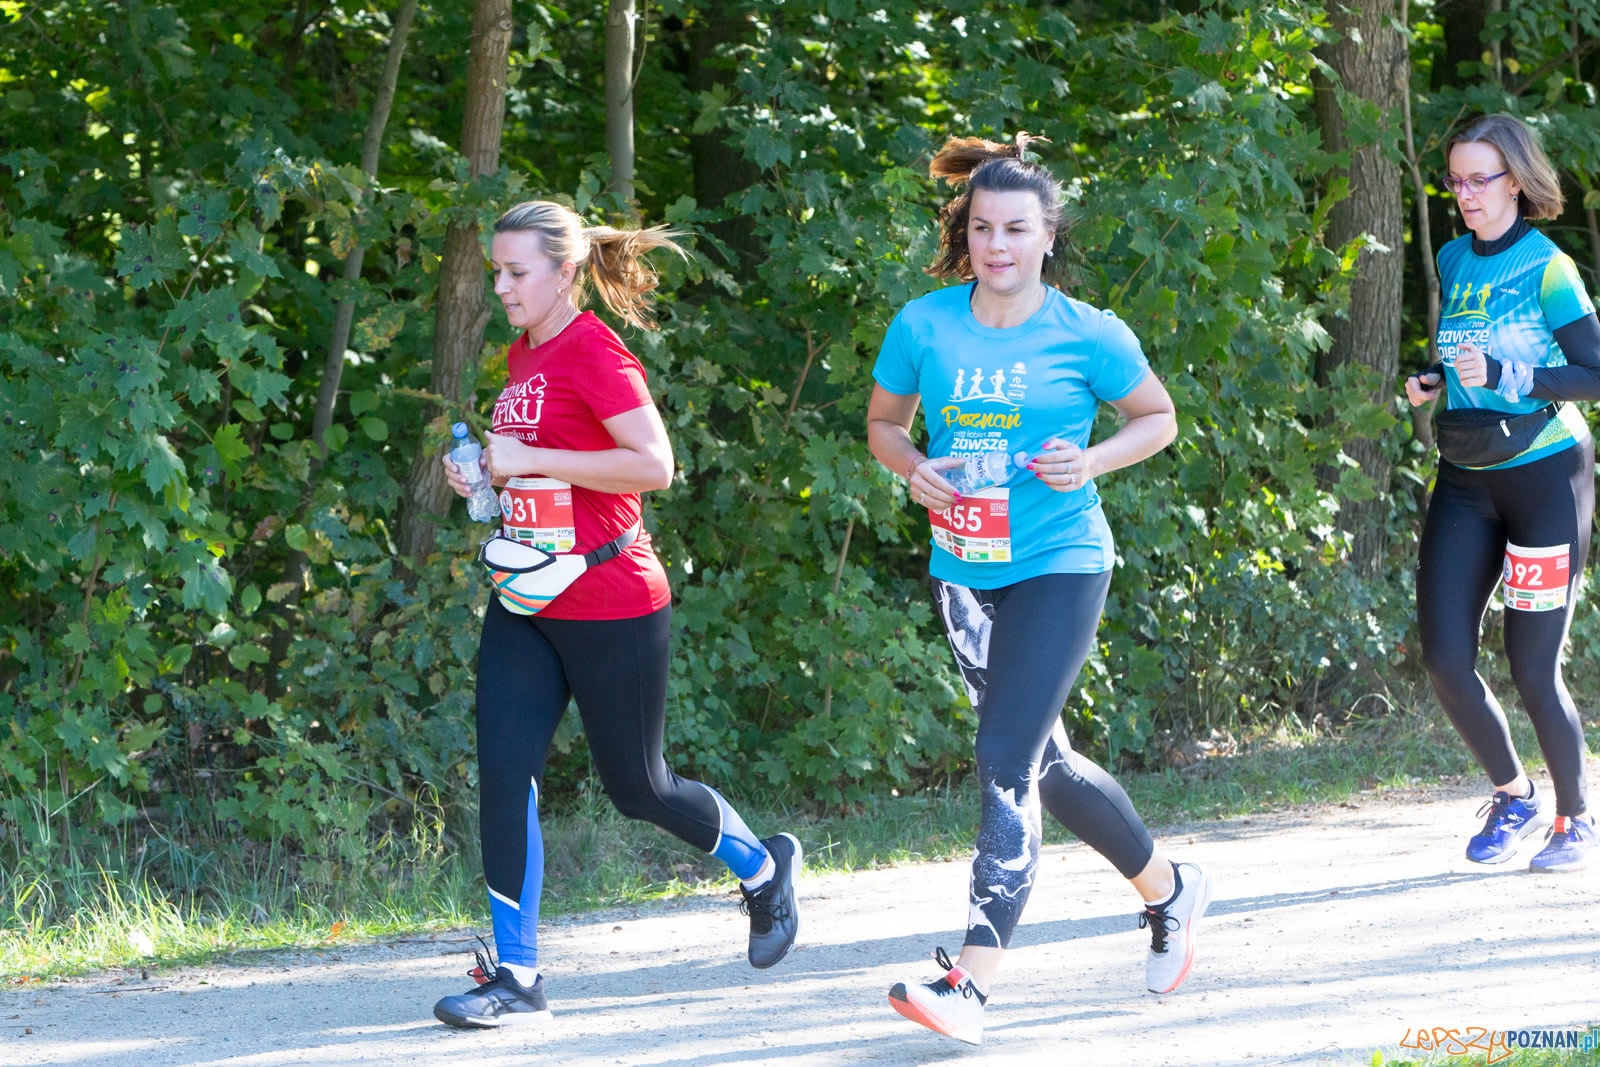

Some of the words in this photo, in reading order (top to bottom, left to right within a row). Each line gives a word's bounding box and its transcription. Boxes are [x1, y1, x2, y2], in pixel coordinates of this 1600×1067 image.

[1437, 329, 1490, 343] zawsze
[492, 398, 544, 425] ZPIKU
[941, 405, 1022, 429] Poznań
[951, 438, 1008, 451] zawsze
[513, 497, 536, 522] 31
[1515, 563, 1543, 586] 92
